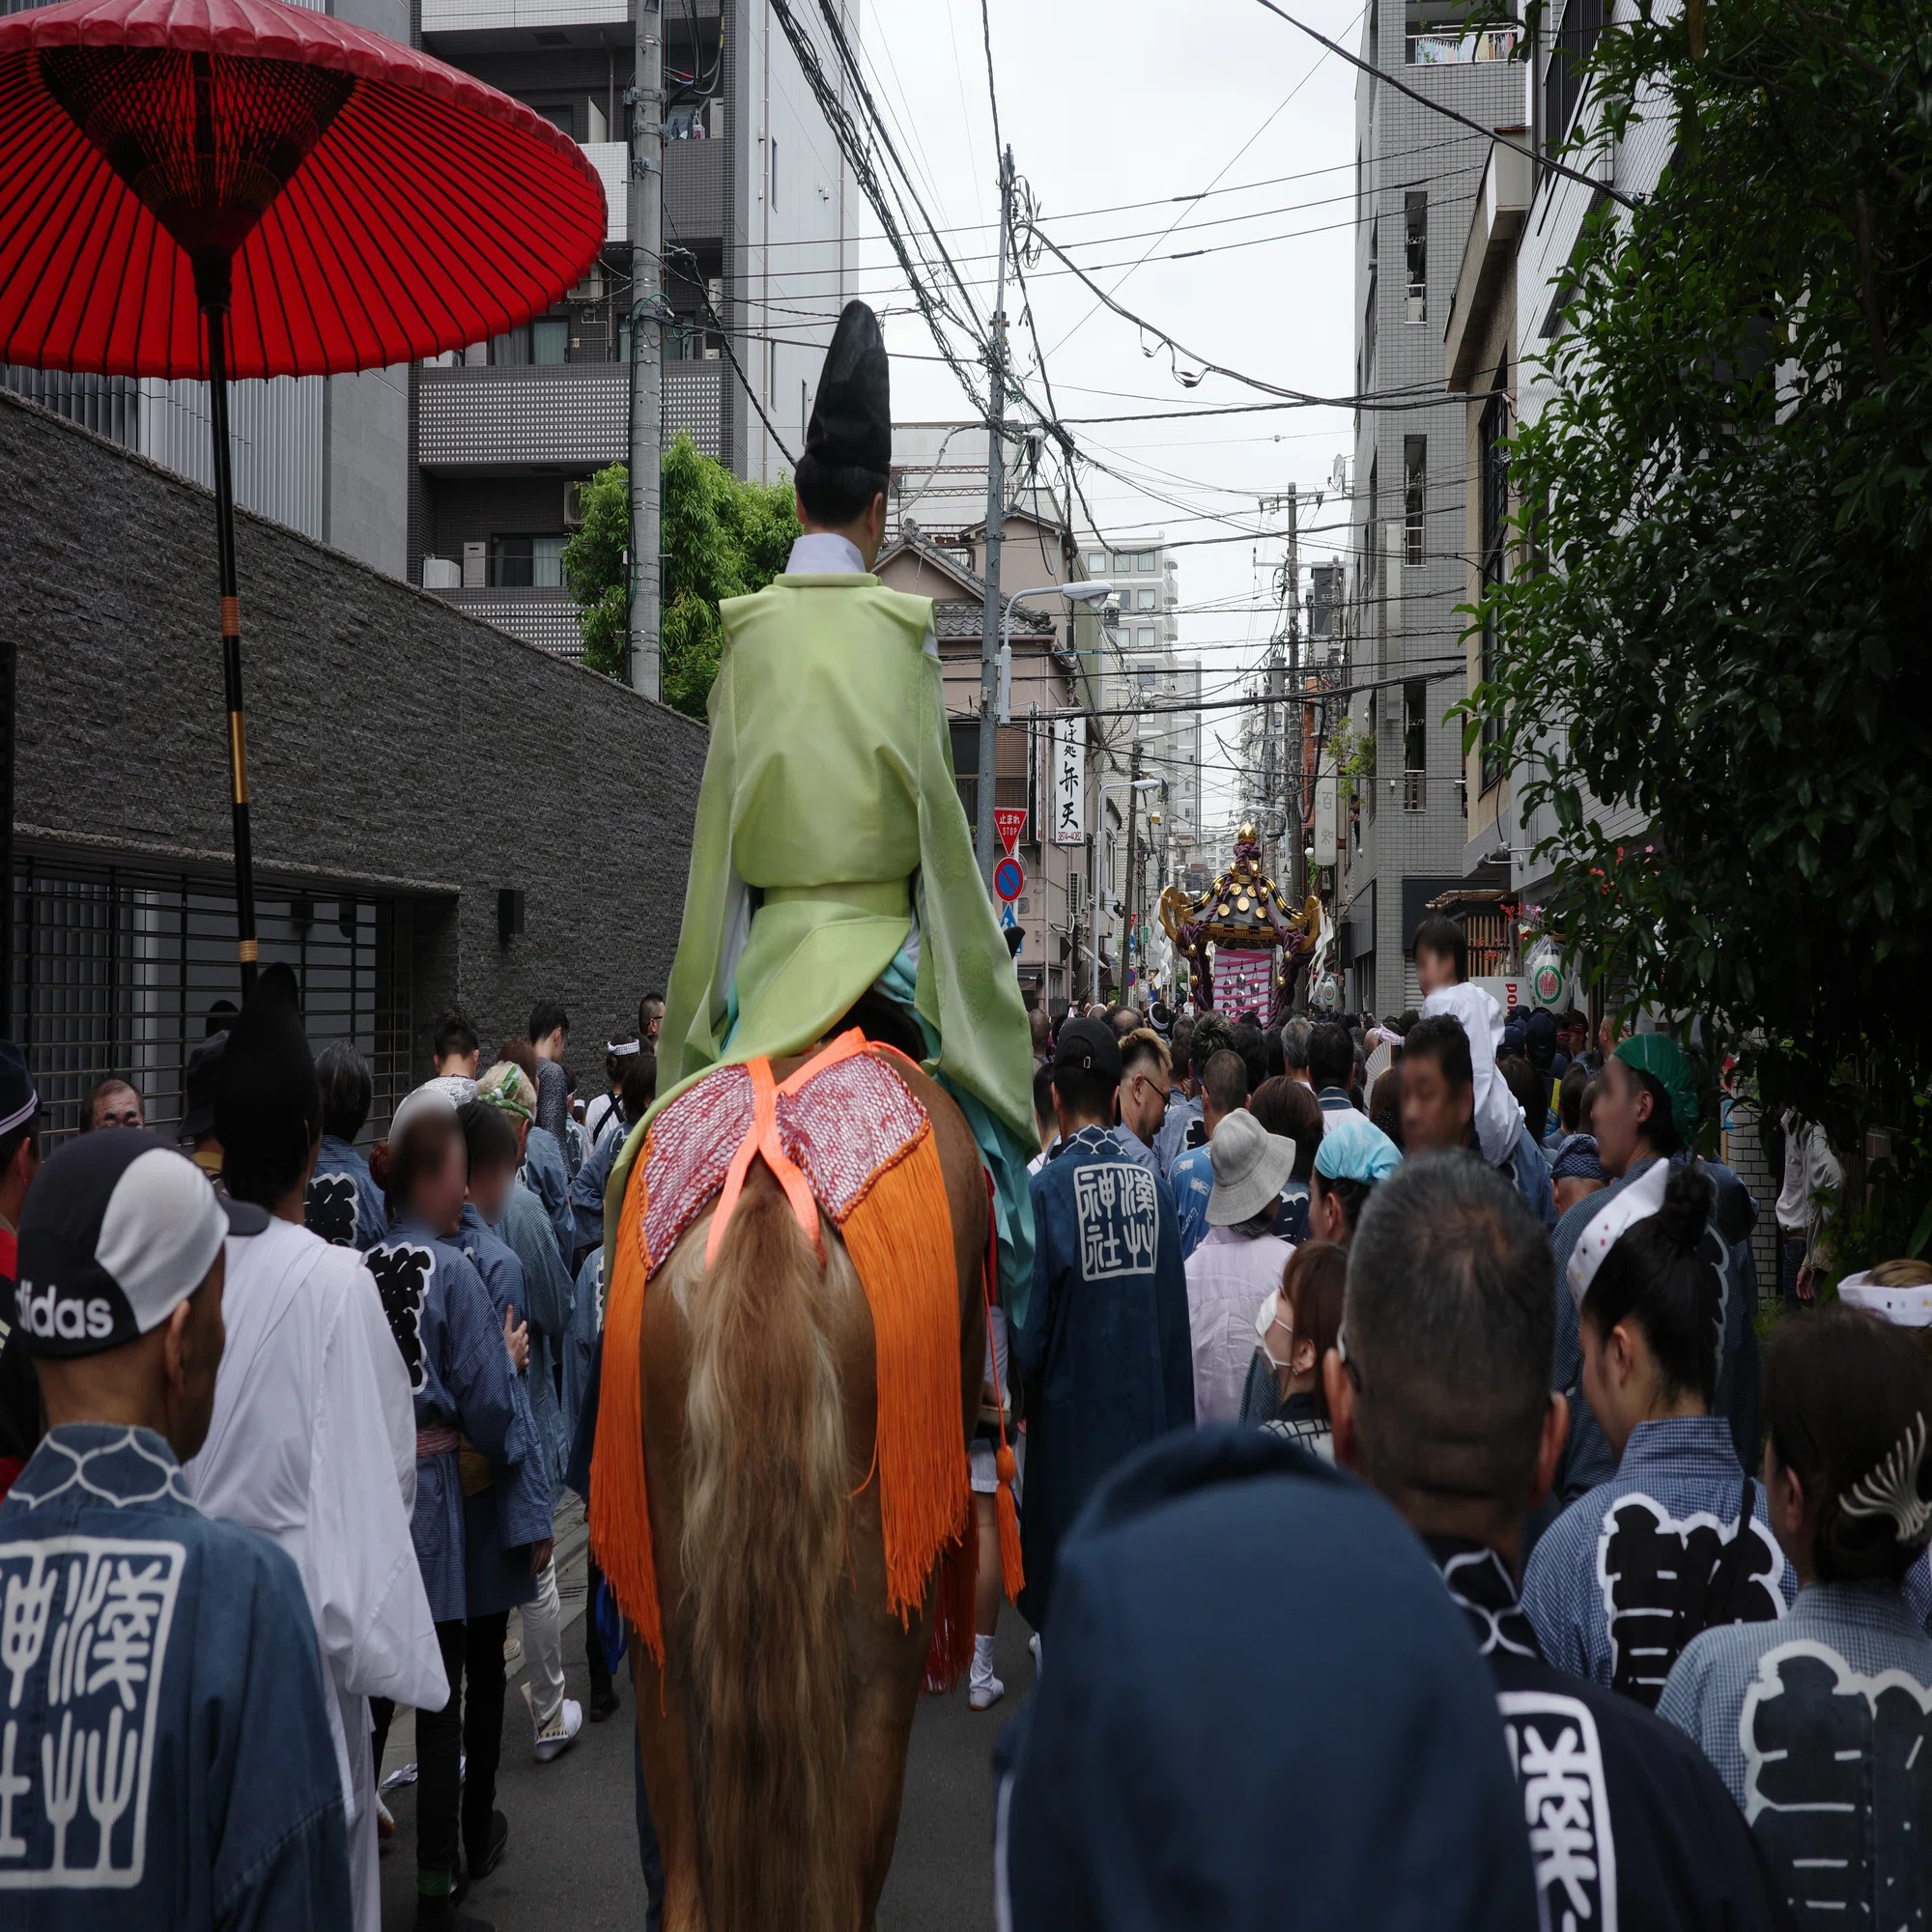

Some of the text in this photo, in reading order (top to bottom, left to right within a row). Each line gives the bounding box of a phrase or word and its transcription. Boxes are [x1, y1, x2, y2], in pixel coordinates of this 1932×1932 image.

[999, 813, 1021, 825] 止まれ
[1002, 826, 1018, 837] STOP
[14, 1278, 115, 1340] didas
